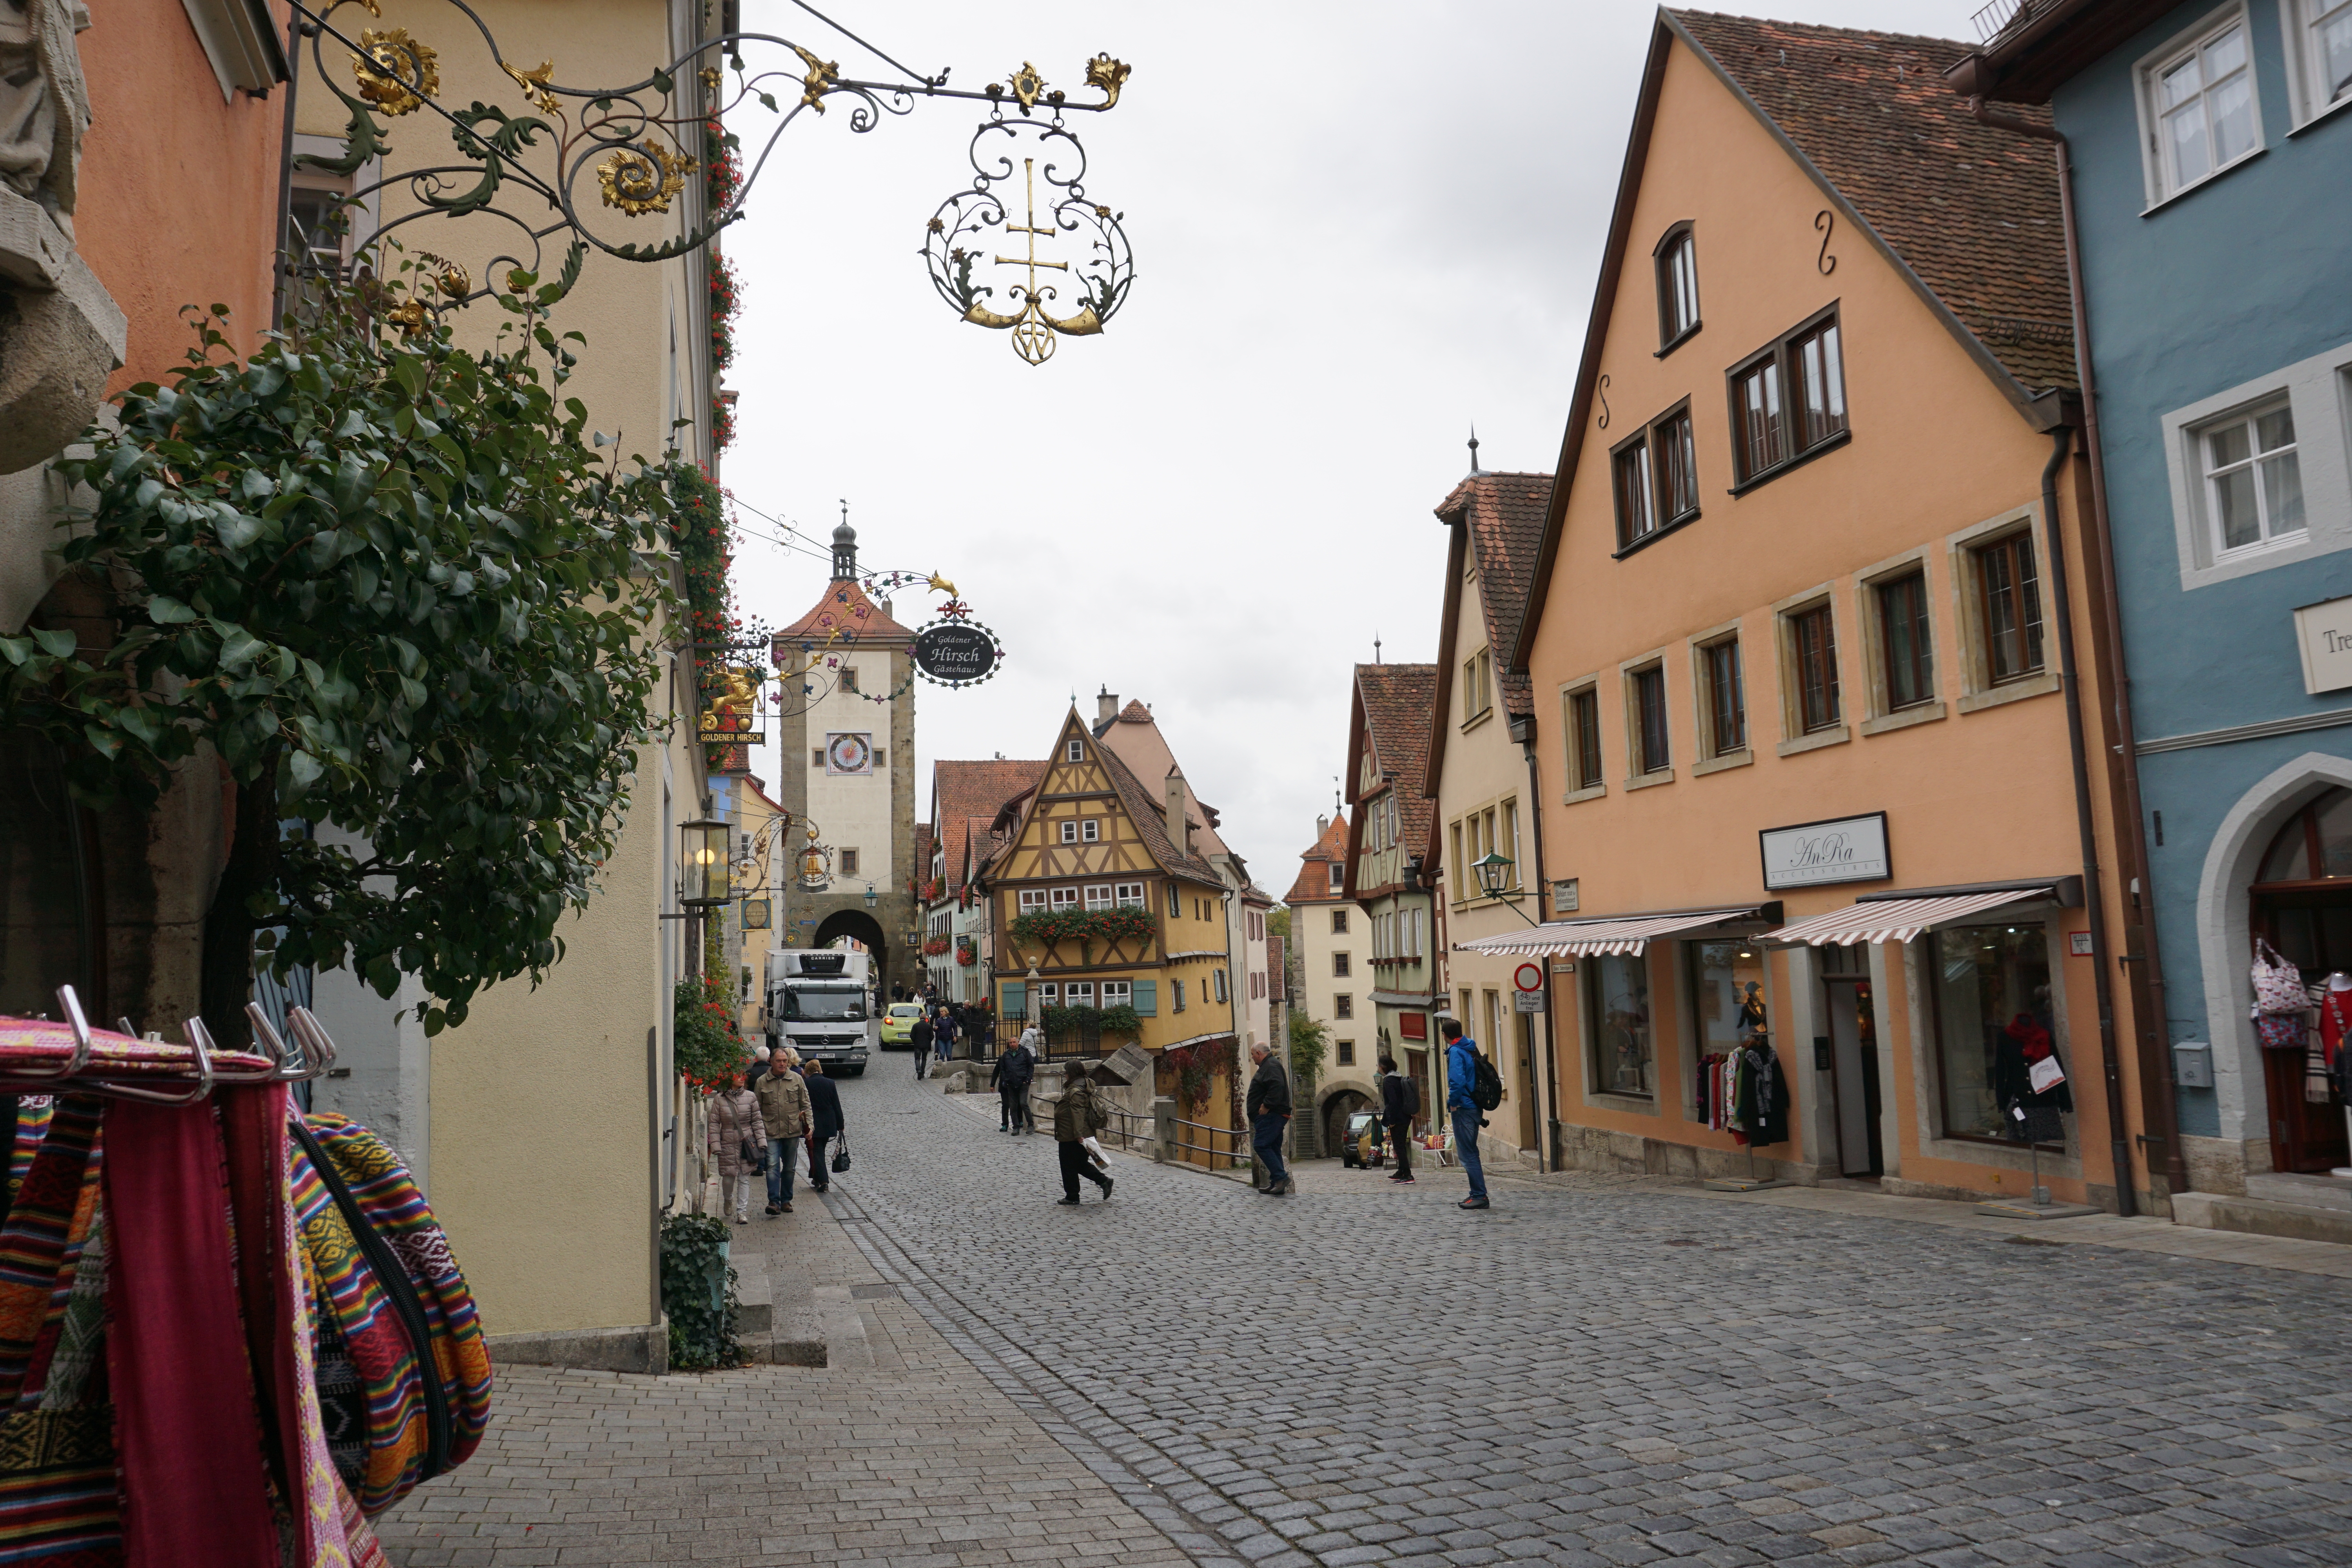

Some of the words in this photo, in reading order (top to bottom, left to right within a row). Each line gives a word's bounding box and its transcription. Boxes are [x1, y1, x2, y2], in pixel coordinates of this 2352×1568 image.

[938, 635, 971, 645] Goldener
[2323, 630, 2352, 653] Tre
[930, 647, 980, 662] Hirsch
[934, 664, 976, 674] Gästehaus
[1790, 832, 1853, 867] AnRa
[1772, 862, 1880, 879] ACCESSOIRES
